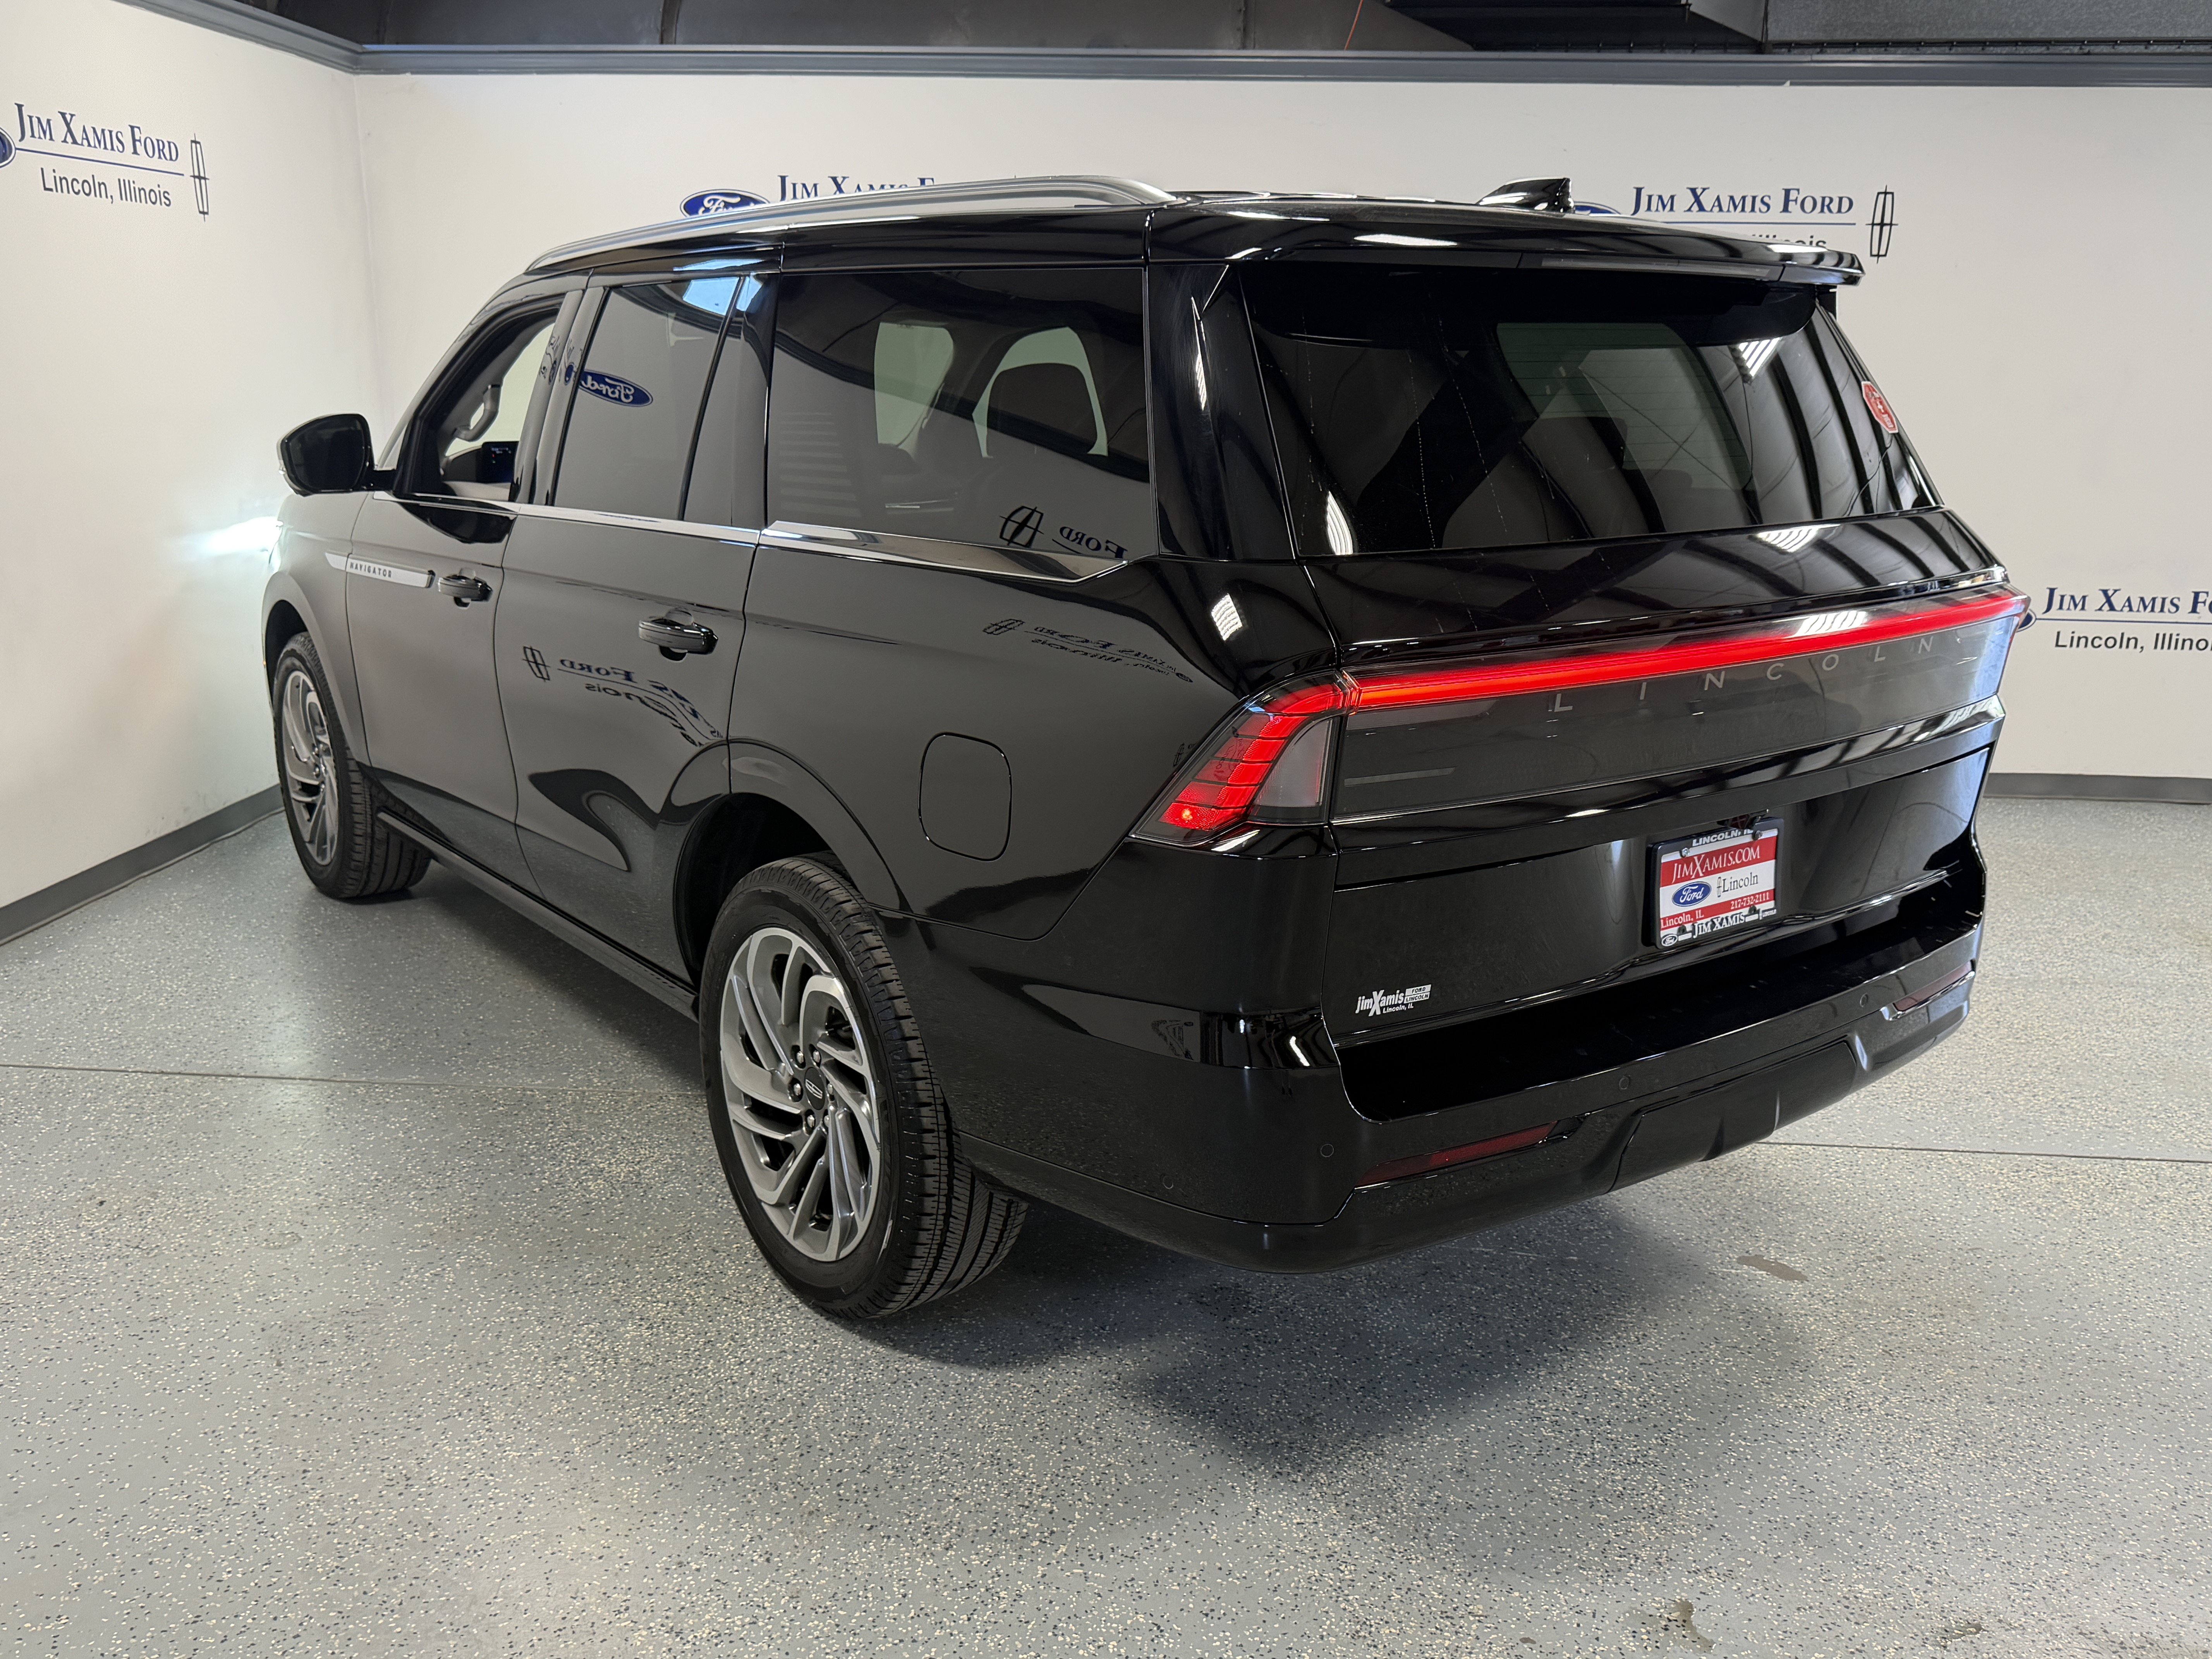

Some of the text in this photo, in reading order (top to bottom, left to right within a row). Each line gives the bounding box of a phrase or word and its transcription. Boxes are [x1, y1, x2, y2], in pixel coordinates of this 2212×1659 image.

[14, 103, 179, 162] JIM XAMIS FORD
[41, 167, 171, 207] Lincoln, Illinois
[1631, 186, 1854, 215] JIM XAMIS FORD
[350, 562, 392, 578] NAVIGATOR
[2042, 587, 2088, 614] JIM
[2095, 588, 2181, 614] XAMIS
[2055, 631, 2145, 653] Lincoln,
[1554, 636, 1934, 712] LINCOLN
[1722, 872, 1759, 893] Lincoln
[1680, 885, 1703, 903] Ford
[1730, 892, 1769, 910] 217-732-2111
[1695, 909, 1705, 919] IL
[1693, 914, 1745, 938] JIM XAMIS
[1405, 993, 1429, 1002] LINCOLN
[1382, 1005, 1407, 1013] Lincoln,
